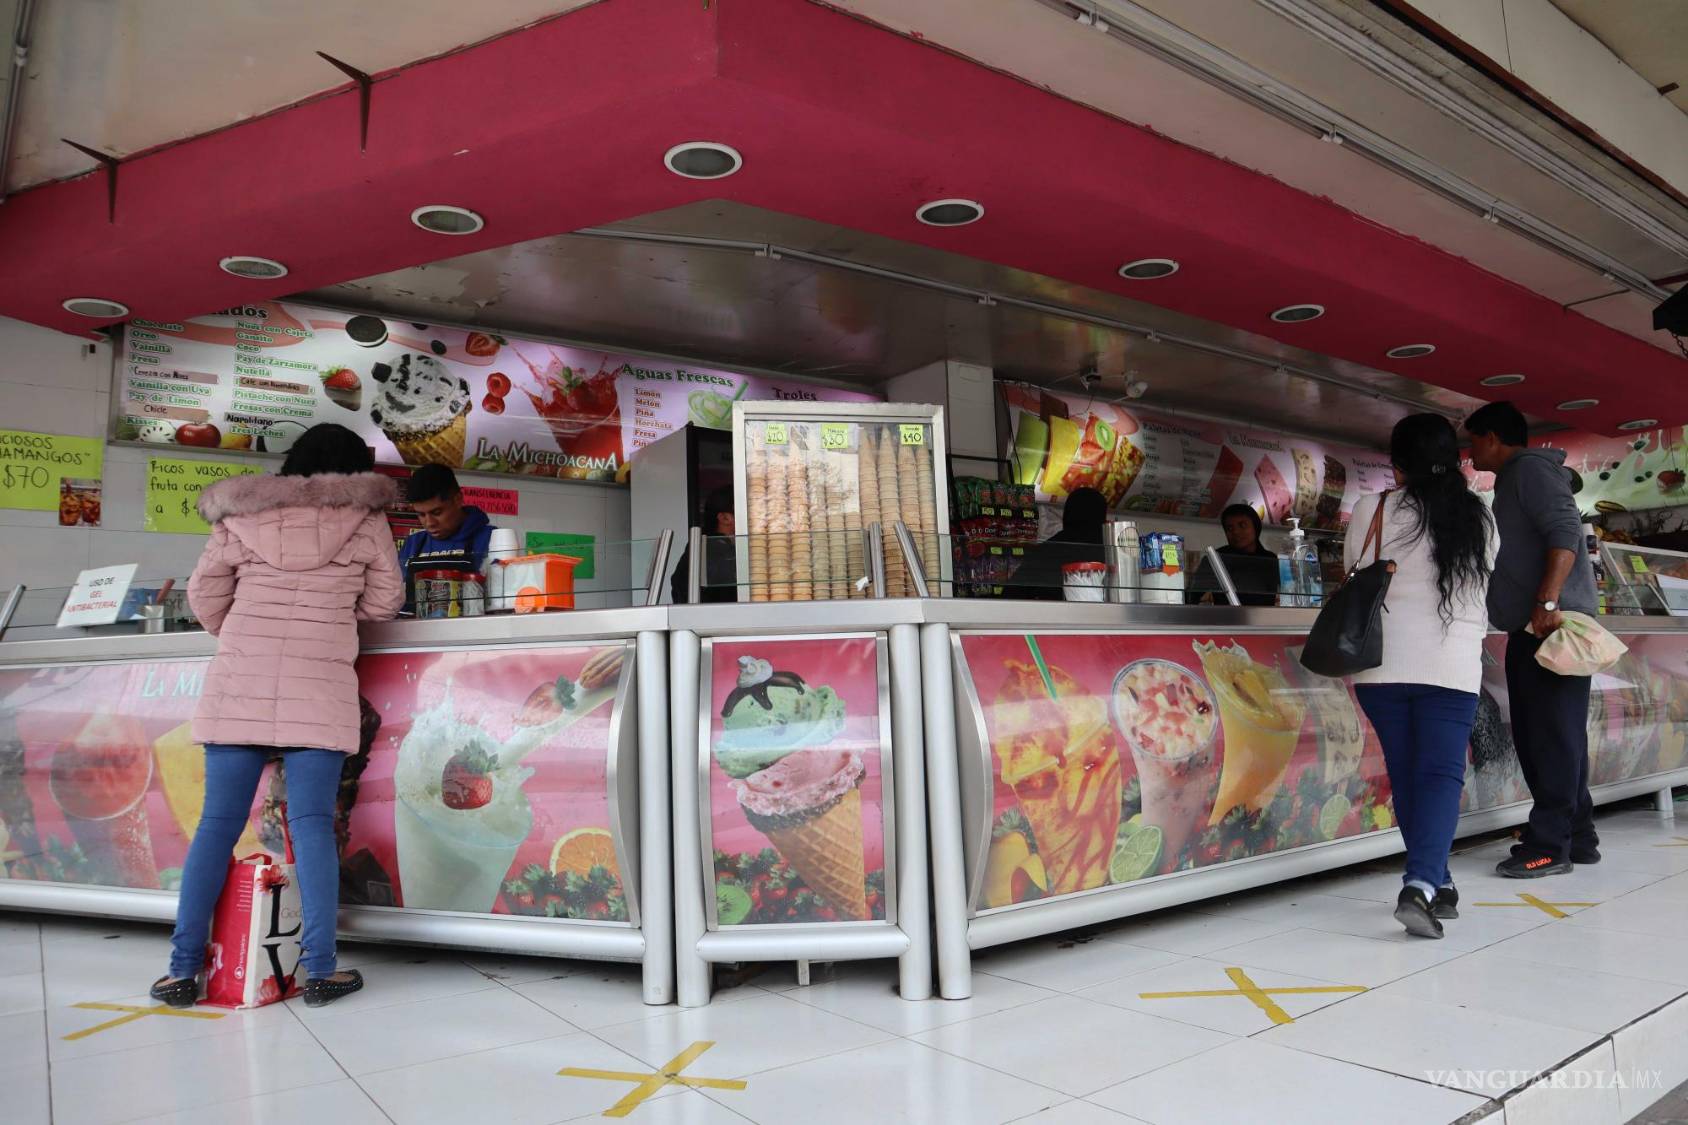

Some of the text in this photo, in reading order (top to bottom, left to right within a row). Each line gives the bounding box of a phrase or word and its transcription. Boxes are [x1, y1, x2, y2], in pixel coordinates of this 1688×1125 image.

[132, 330, 157, 339] Oreo
[130, 340, 172, 353] Vainilla
[236, 344, 260, 352] Coco
[131, 353, 159, 363] Fresa
[236, 354, 317, 370] Pay de Zarzamora
[236, 366, 270, 376] Nutella
[623, 364, 735, 388] Aguas Frescas
[130, 380, 210, 394] Vainilla con Uva
[129, 391, 145, 401] Pay
[152, 393, 162, 401] de
[235, 390, 274, 401] Pistache
[295, 396, 315, 405] Nuez
[233, 402, 262, 412] Fresas
[283, 408, 312, 417] Crema
[127, 416, 158, 426] Kisses
[231, 425, 285, 437] Tres Leches
[634, 429, 656, 438] Fresa
[0, 435, 52, 450] CIOSOS
[477, 438, 618, 471] LA MICHOACANA
[3, 464, 49, 489] $70
[195, 465, 231, 478] vasos
[150, 476, 202, 491] fruta con
[155, 504, 164, 514] a
[89, 577, 116, 587] USO DE
[67, 600, 118, 612] ANTIBACTERIAL
